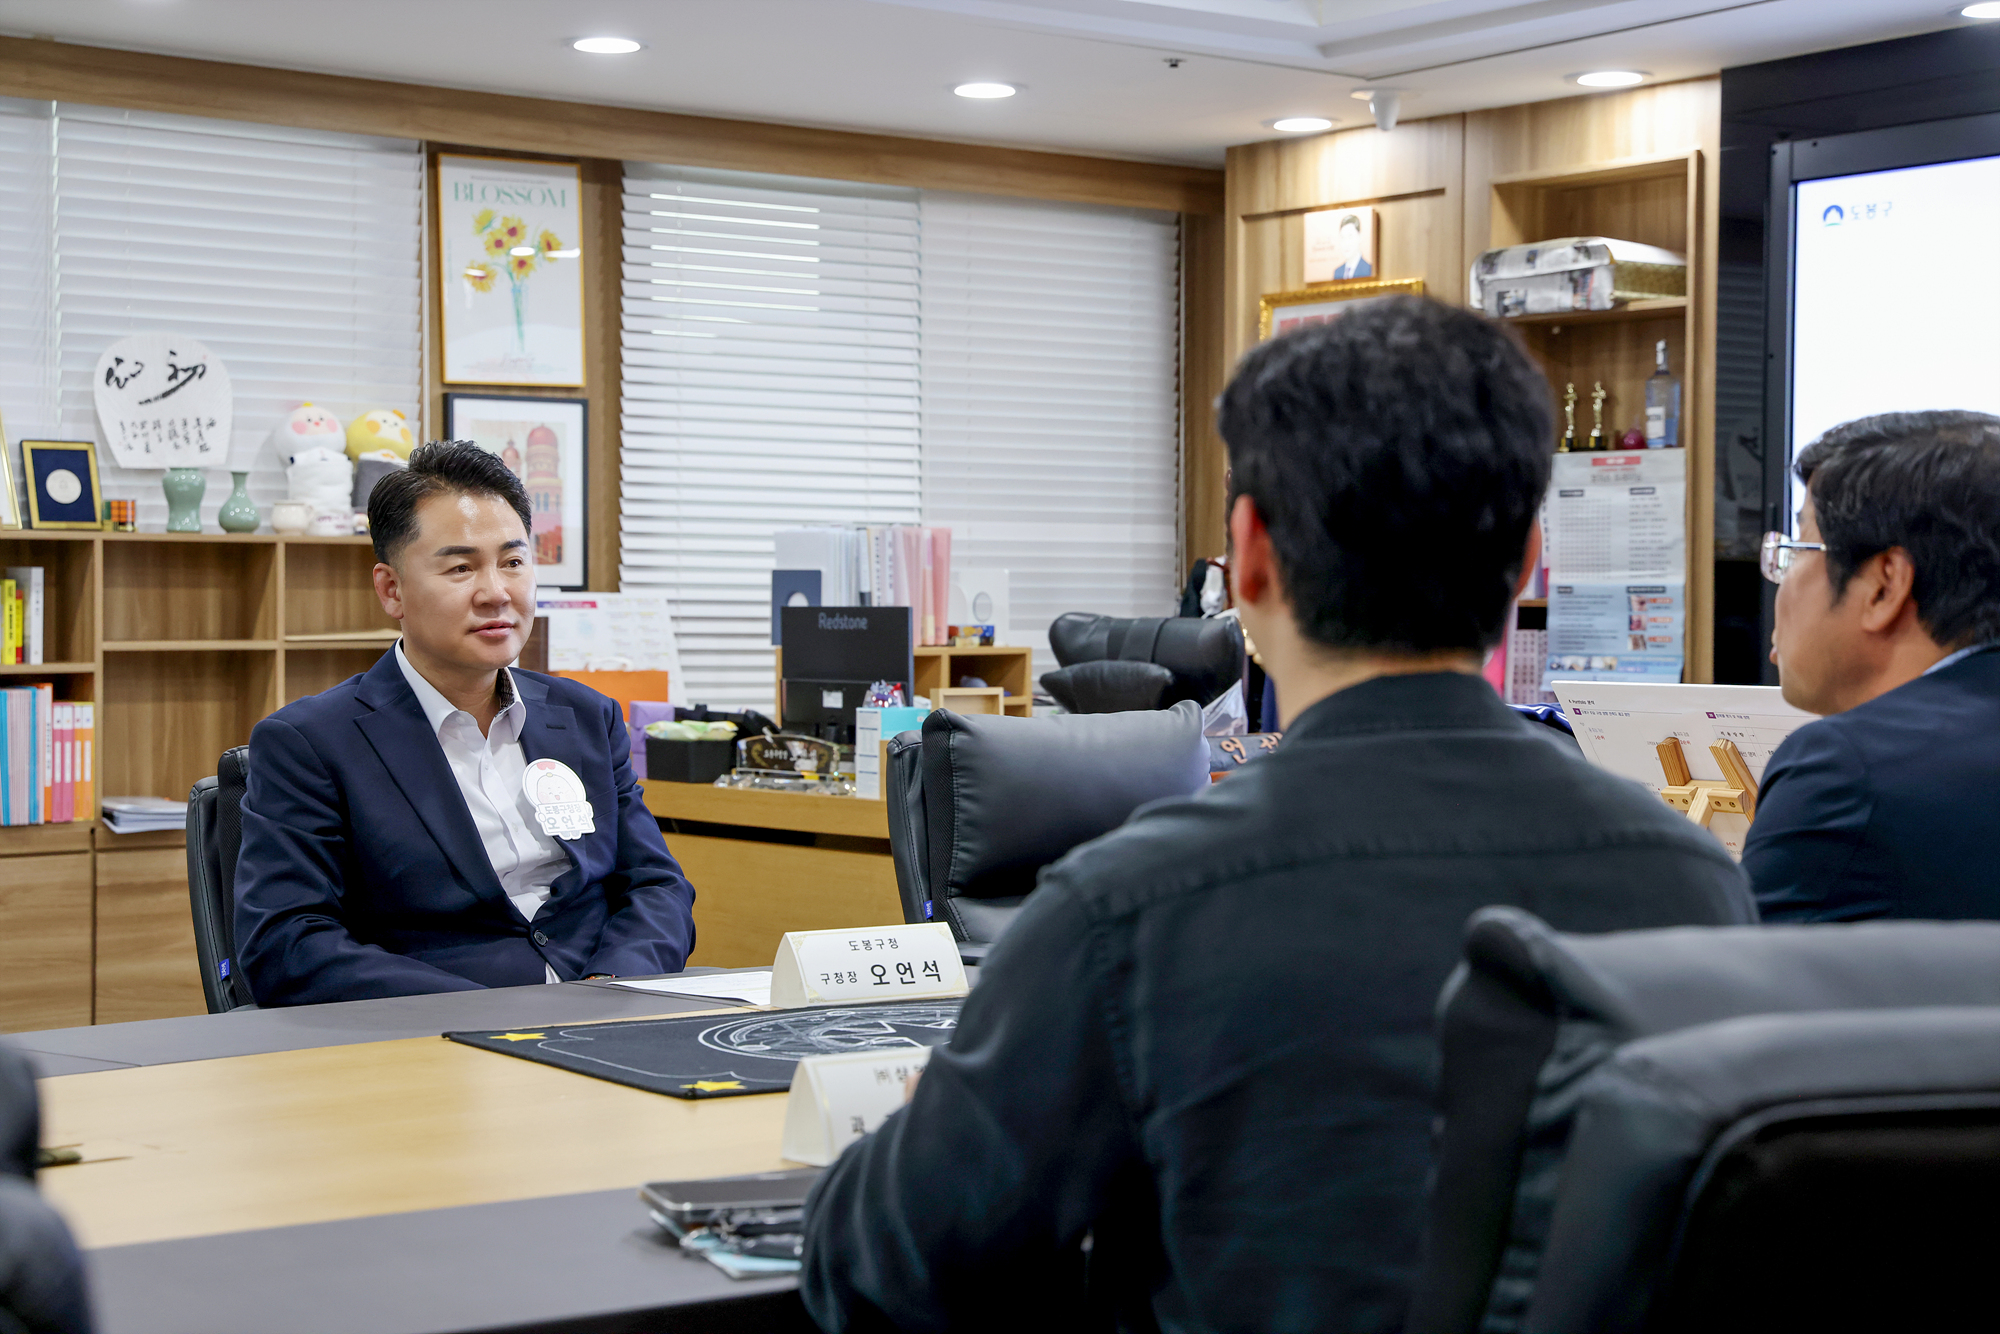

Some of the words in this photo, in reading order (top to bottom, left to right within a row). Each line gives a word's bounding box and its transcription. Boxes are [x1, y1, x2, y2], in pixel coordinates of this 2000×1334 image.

[453, 181, 566, 208] BLOSSOM
[1850, 201, 1893, 220] 도봉구
[818, 612, 868, 630] Redstone
[544, 804, 582, 815] 도봉구청장
[547, 813, 591, 830] 오언석
[848, 938, 899, 951] 도봉구청
[820, 971, 858, 985] 구청장
[870, 960, 942, 986] 오언석
